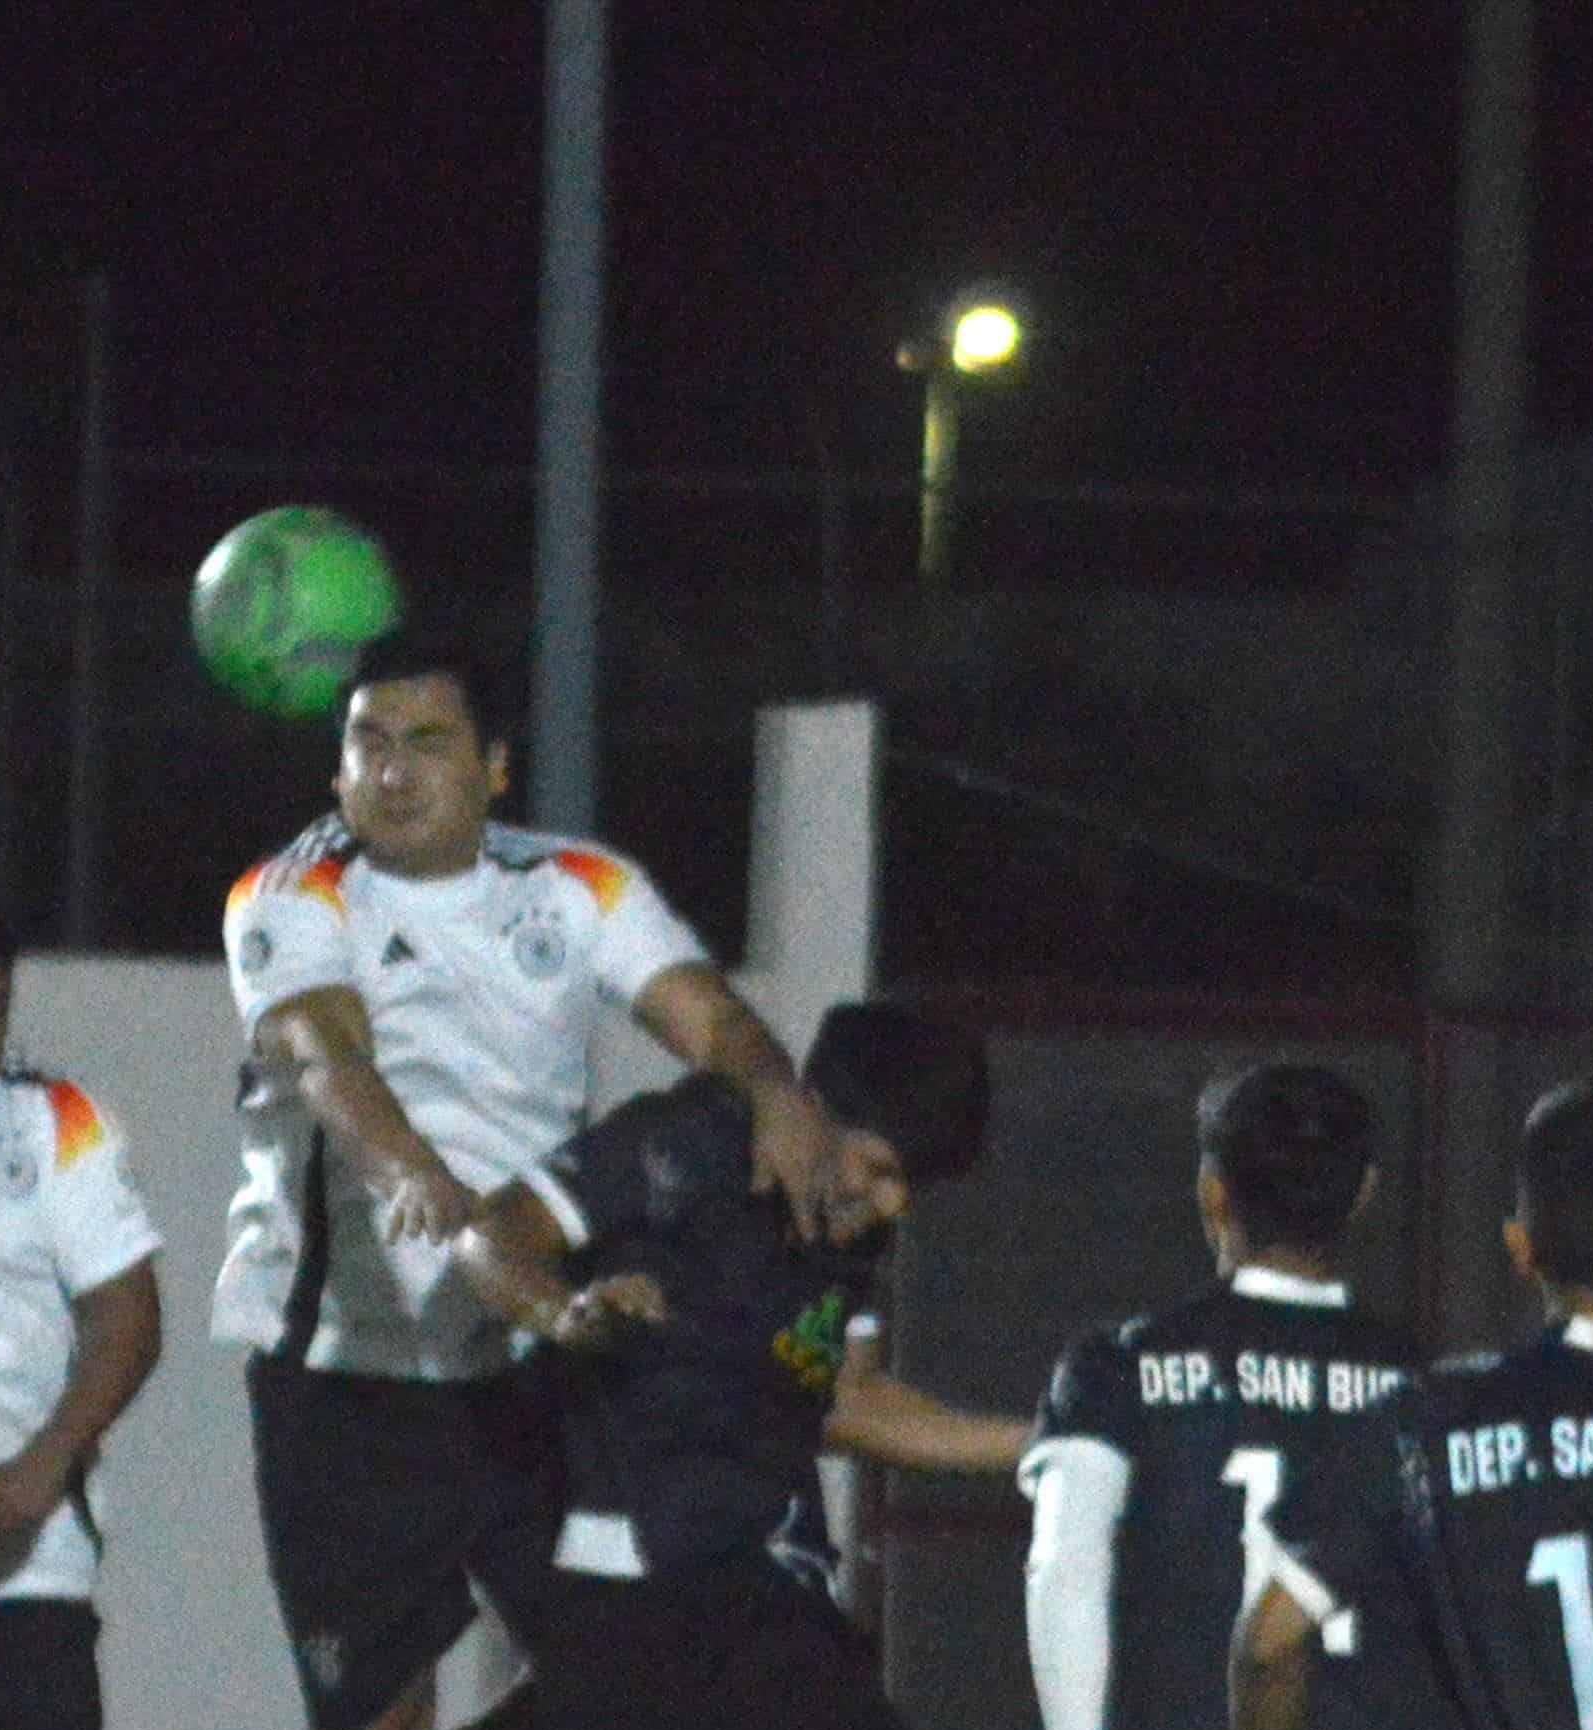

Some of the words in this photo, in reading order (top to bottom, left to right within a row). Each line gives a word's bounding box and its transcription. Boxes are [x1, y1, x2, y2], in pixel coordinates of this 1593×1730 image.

[1138, 1351, 1226, 1405] DEP.
[1235, 1350, 1316, 1412] SAN
[1446, 1420, 1539, 1496] DEP.
